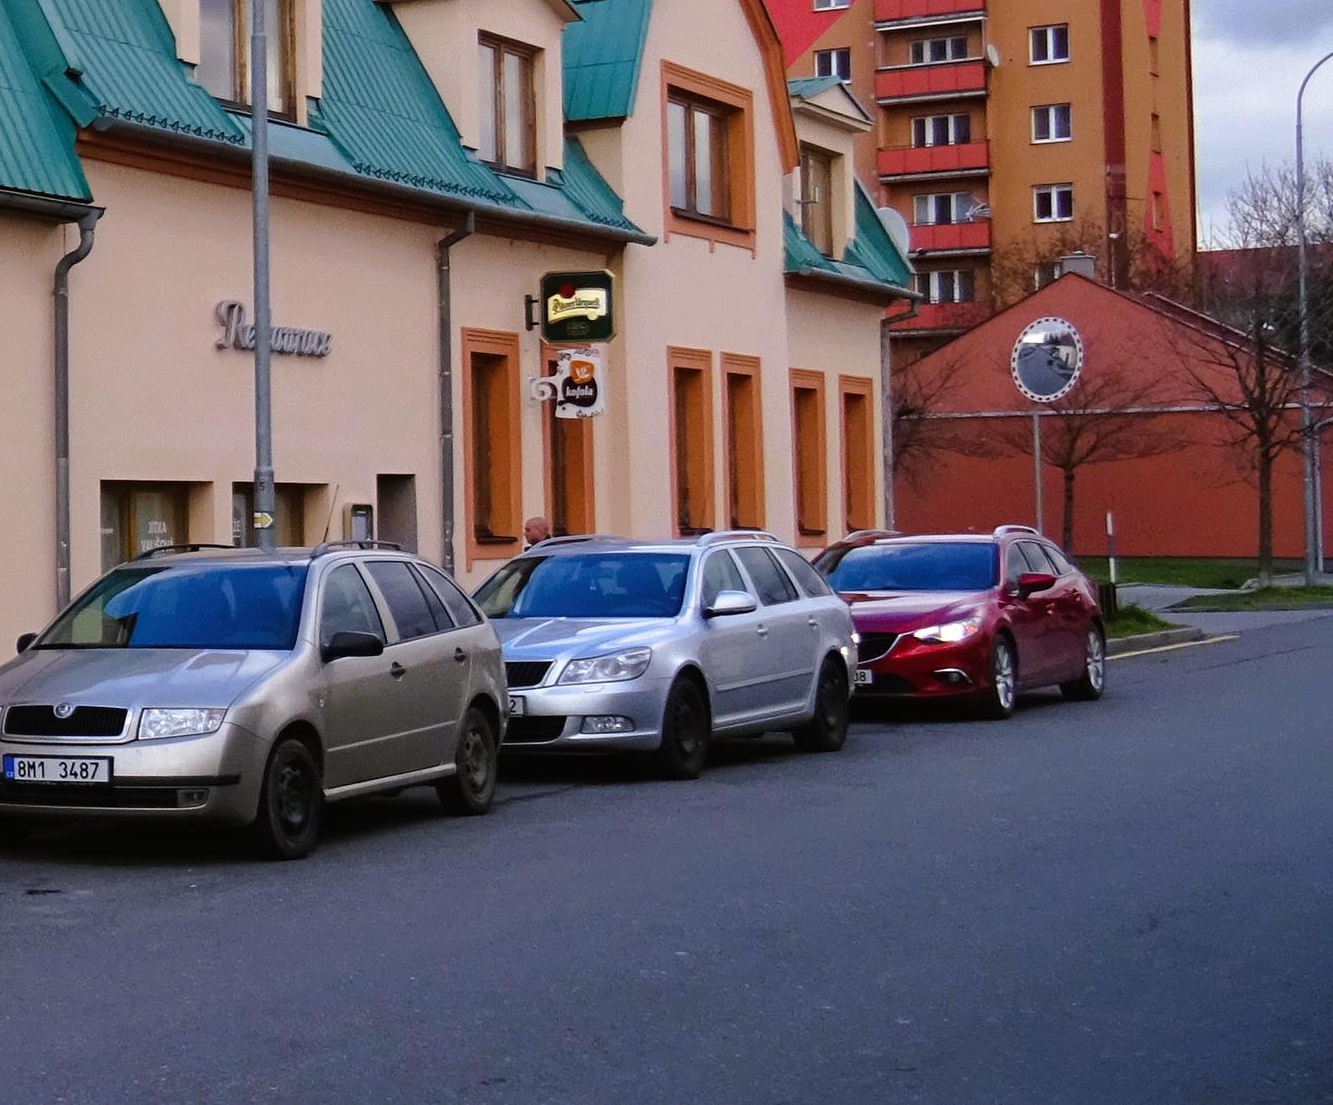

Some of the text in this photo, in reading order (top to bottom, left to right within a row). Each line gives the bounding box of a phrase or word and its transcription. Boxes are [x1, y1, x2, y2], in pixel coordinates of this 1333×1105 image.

[215, 300, 332, 359] Reaurace
[17, 760, 100, 780] 8M1 3487
